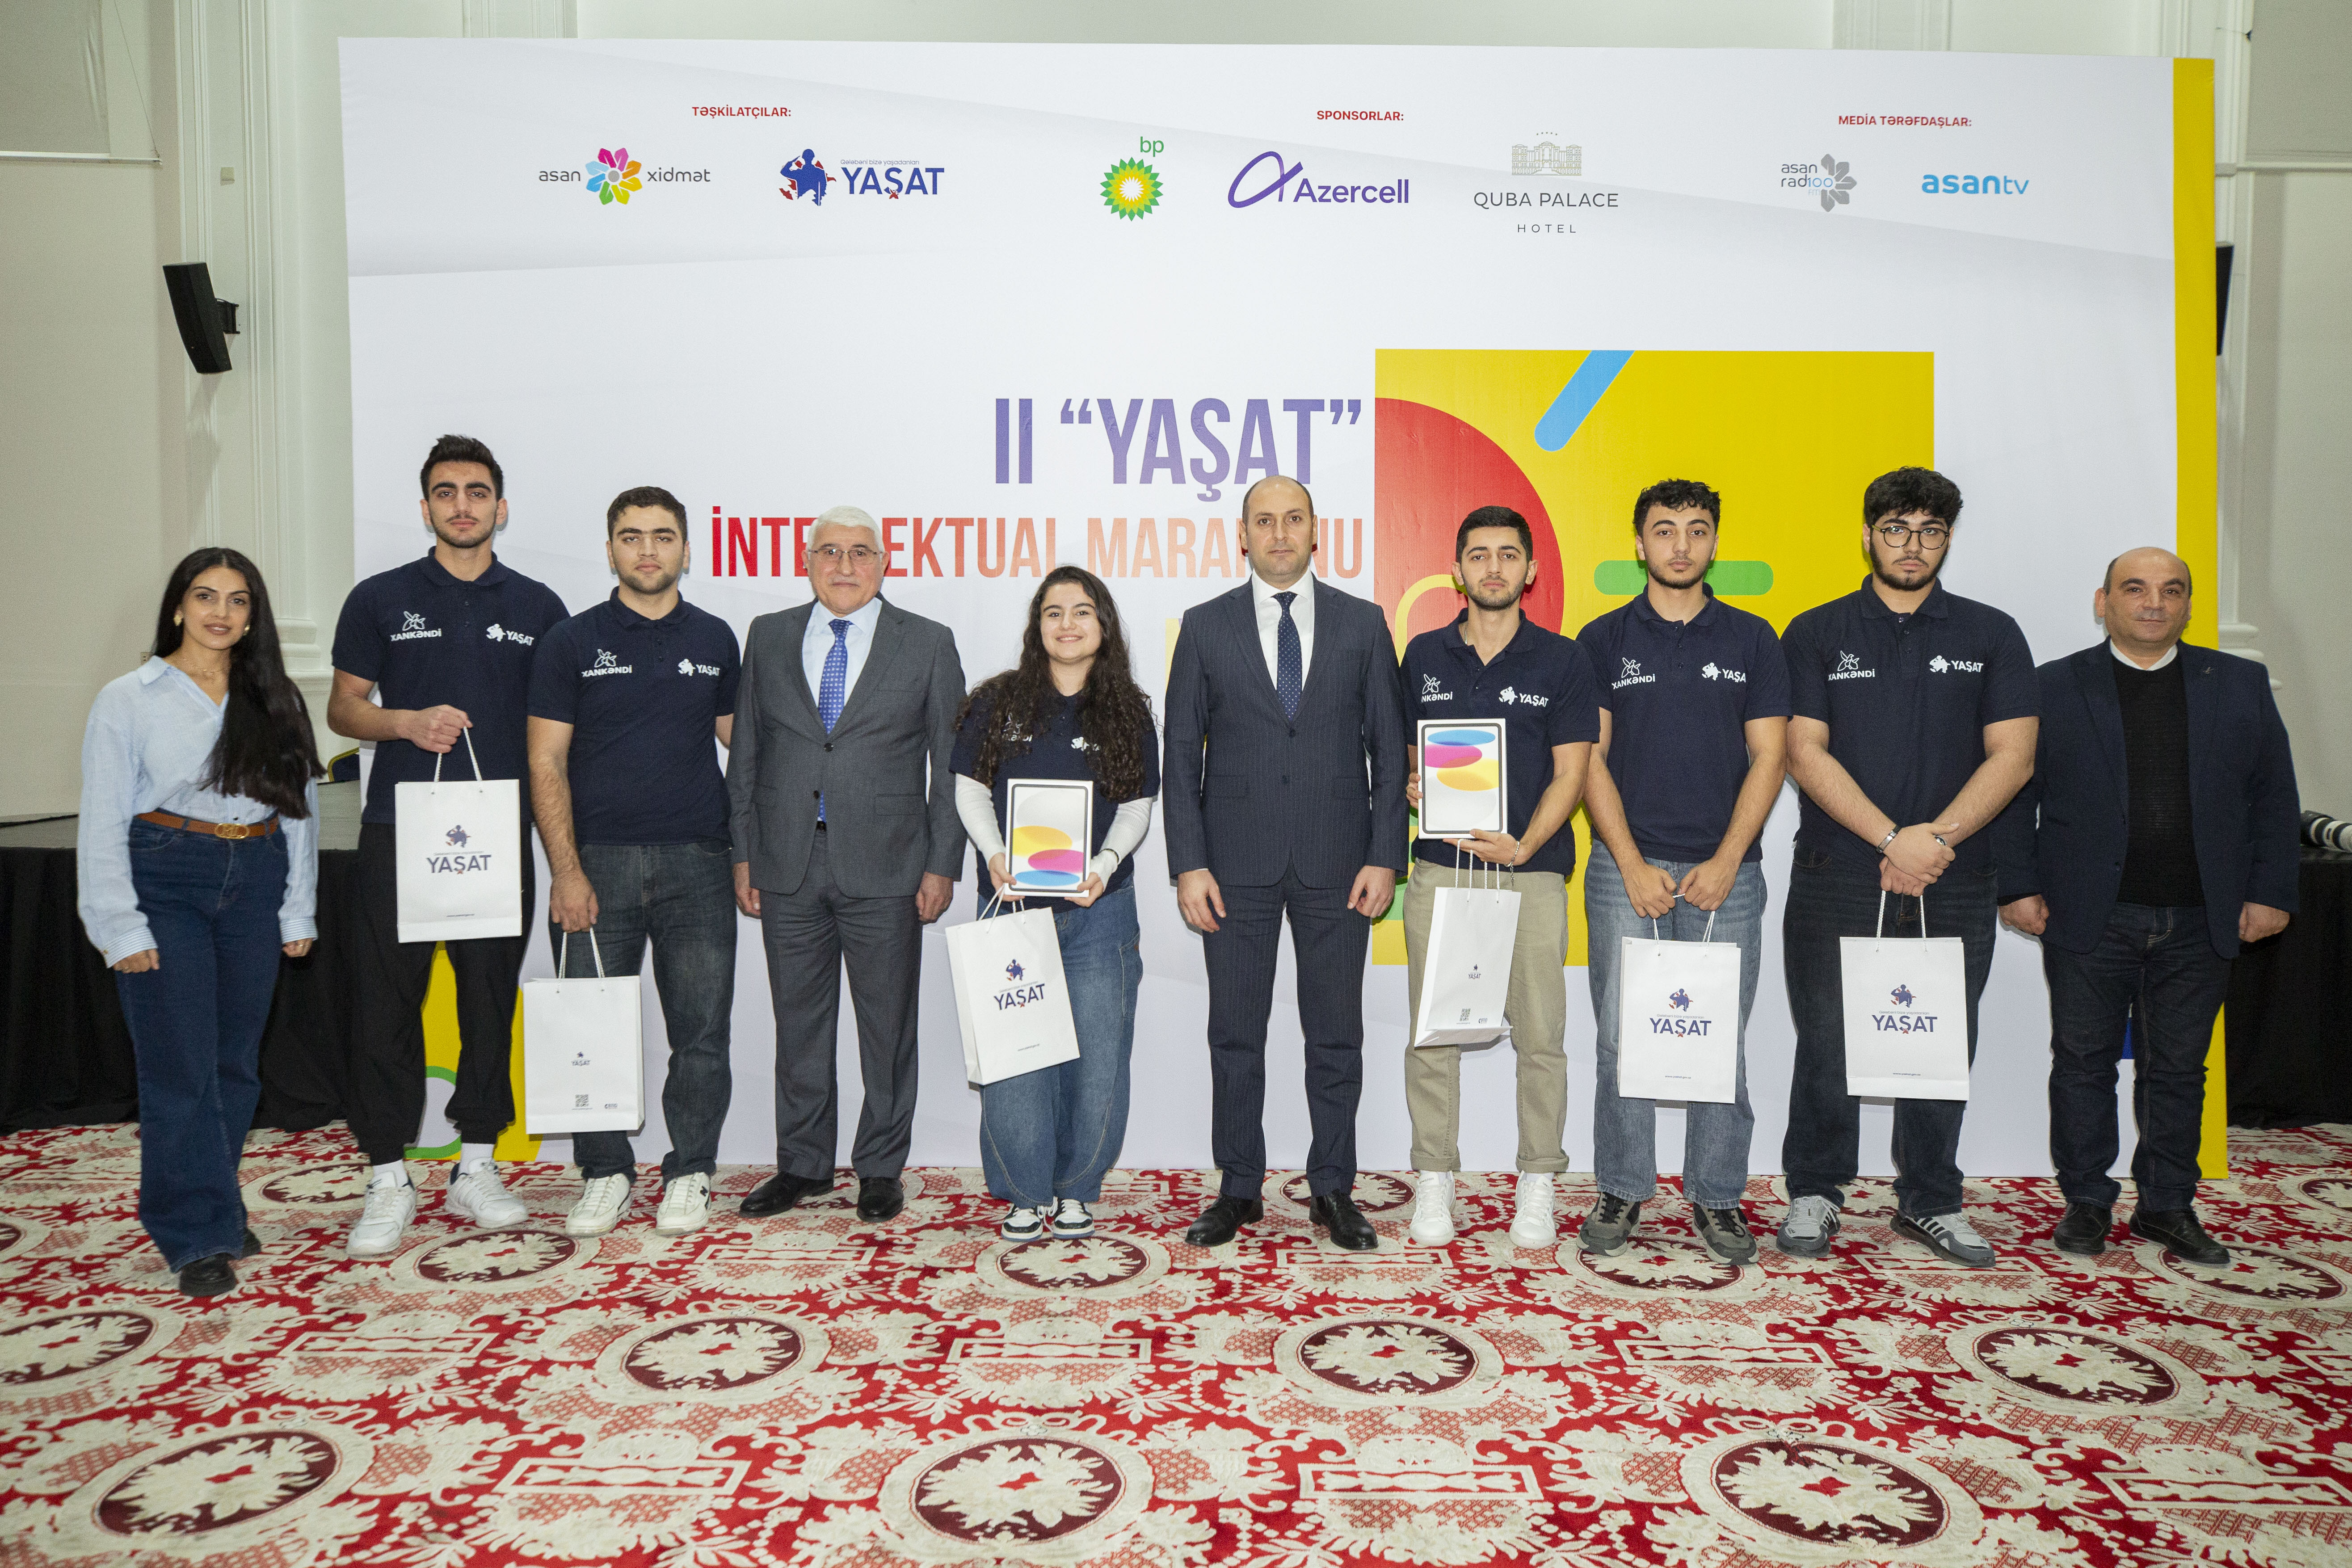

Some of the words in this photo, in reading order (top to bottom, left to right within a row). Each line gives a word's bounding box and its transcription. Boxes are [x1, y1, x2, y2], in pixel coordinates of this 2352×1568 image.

[692, 104, 791, 119] TƏŞKİLATÇILAR:
[1317, 110, 1404, 121] SPONSORLAR:
[1839, 114, 1877, 125] MEDİA
[1880, 116, 1972, 129] TƏRƏFDAŞLAR:
[1140, 136, 1164, 157] bp
[539, 171, 581, 182] asan
[647, 167, 711, 182] xidmət
[1781, 164, 1818, 173] asan
[841, 167, 945, 199] YAŞAT
[1293, 178, 1409, 203] Azercell
[1474, 192, 1532, 210] QUBA
[1540, 193, 1619, 207] PALACE
[1517, 224, 1576, 233] HOTEL
[995, 398, 1033, 484] II
[712, 506, 1056, 578] İNTEEKTUAL
[1951, 660, 1984, 673] YAŞAT
[1611, 673, 1655, 689] XANKƏNDİ
[1722, 668, 1746, 683] YAŞA
[1828, 668, 1875, 681] XANKƏNDİ
[1519, 693, 1549, 707] YAŞAT
